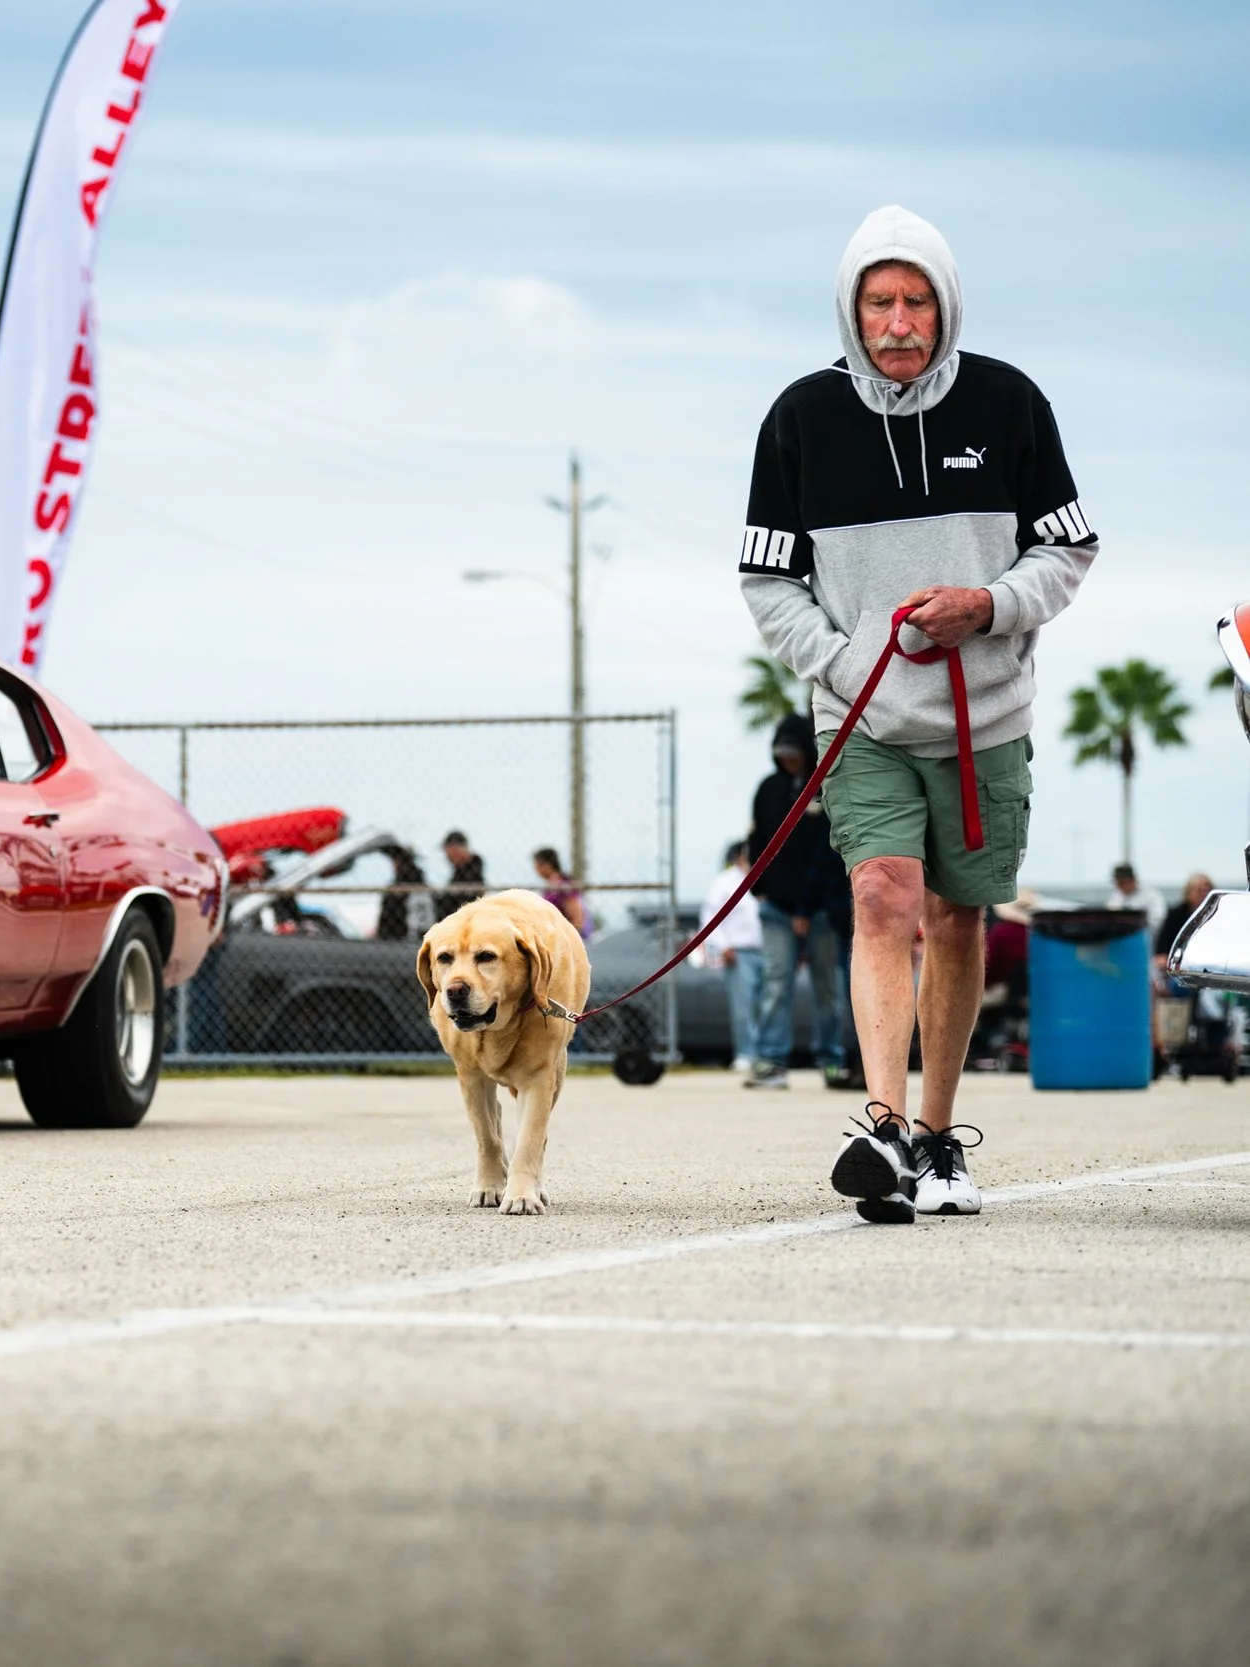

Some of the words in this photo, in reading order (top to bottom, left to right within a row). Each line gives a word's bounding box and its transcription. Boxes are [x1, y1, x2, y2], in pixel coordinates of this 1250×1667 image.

[79, 0, 167, 229] ALLEY
[943, 457, 978, 469] PUMA
[1033, 499, 1091, 545] PU
